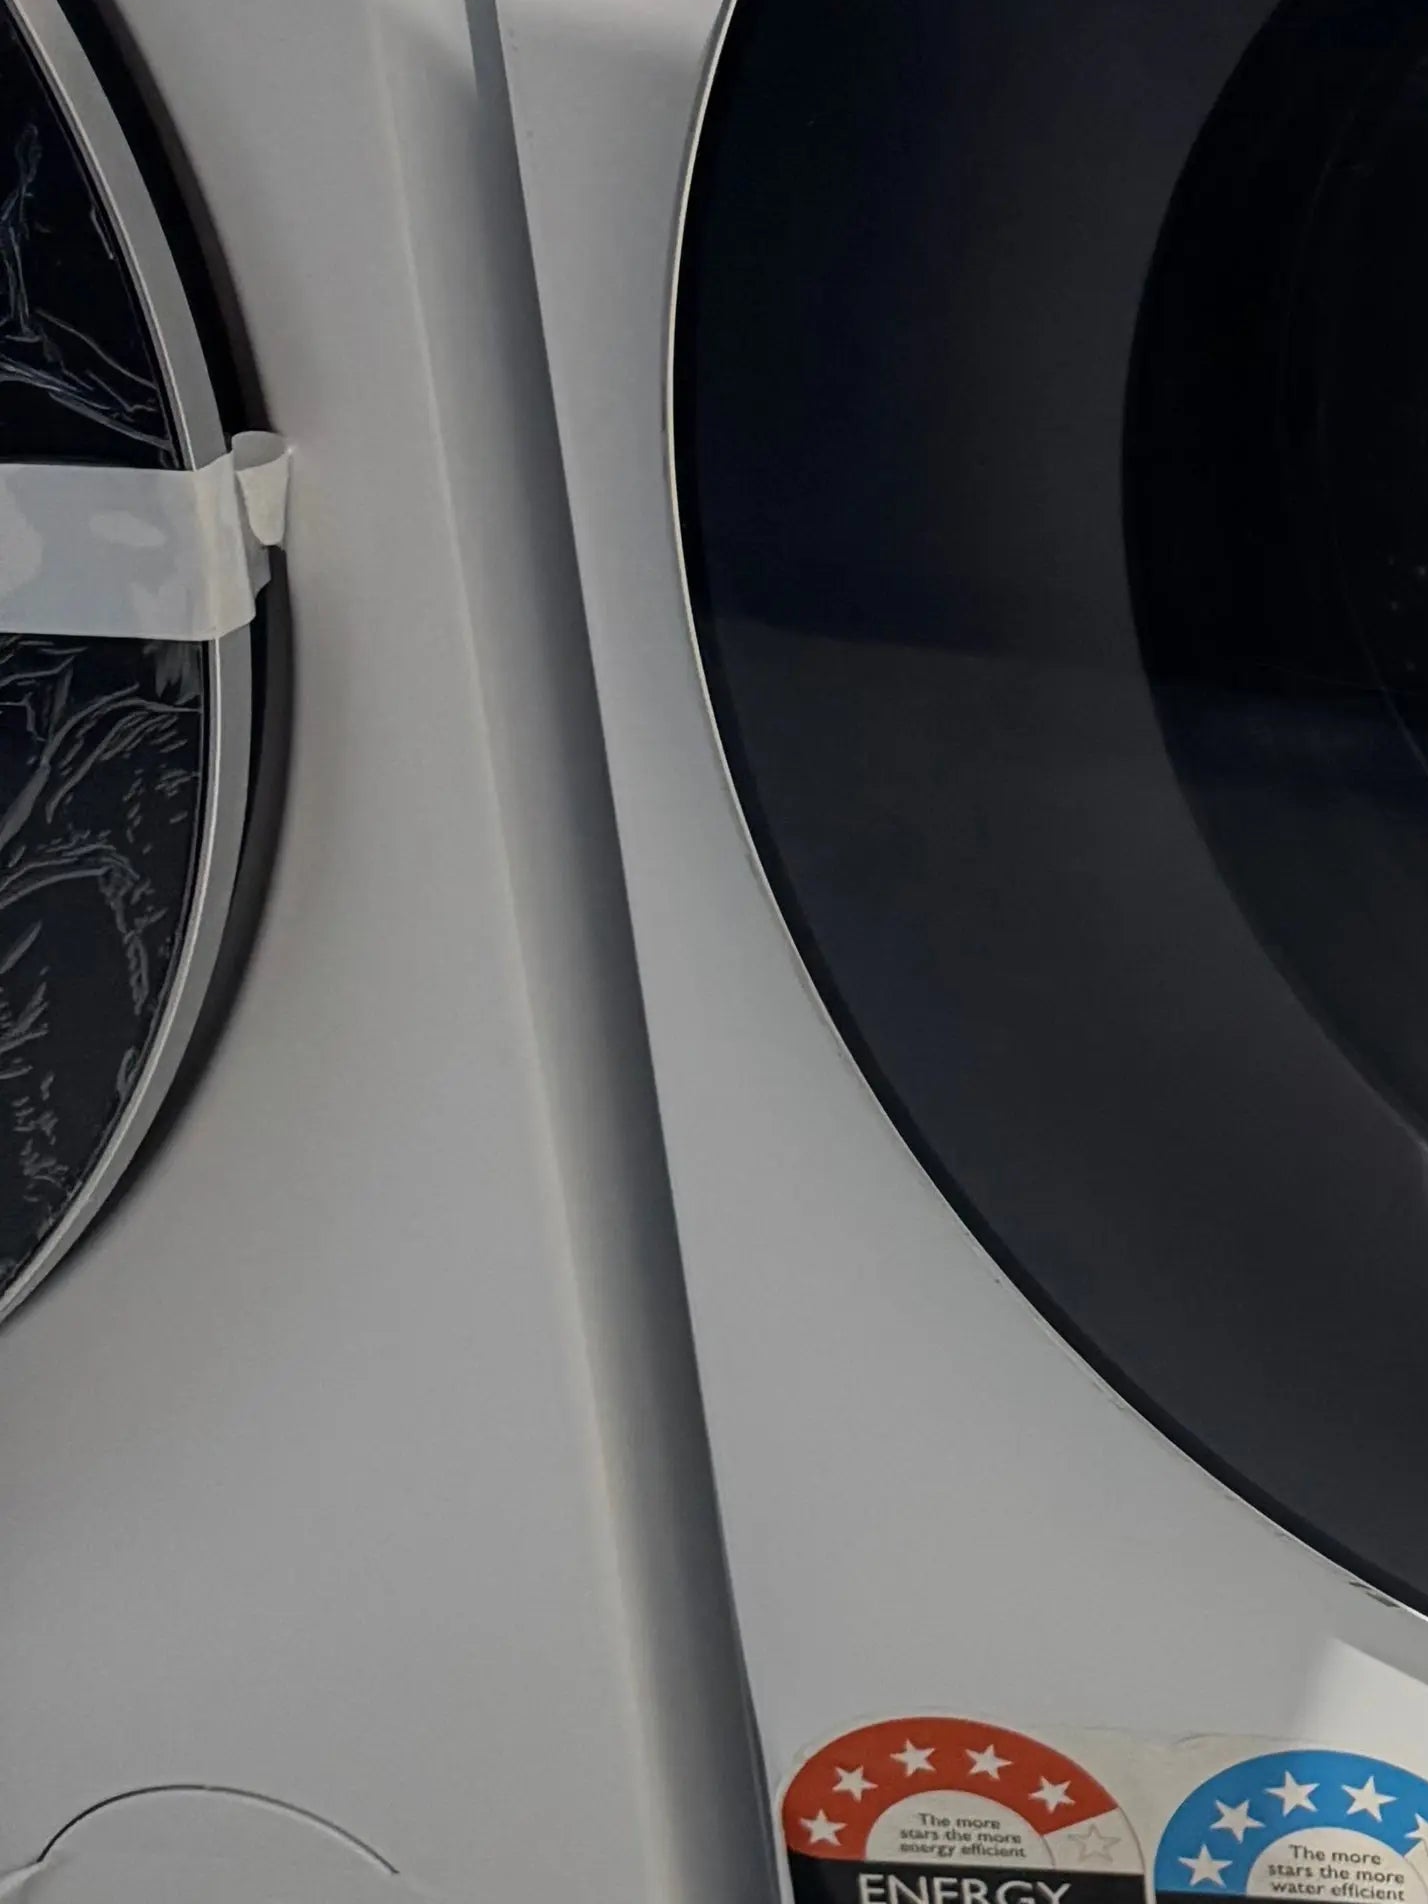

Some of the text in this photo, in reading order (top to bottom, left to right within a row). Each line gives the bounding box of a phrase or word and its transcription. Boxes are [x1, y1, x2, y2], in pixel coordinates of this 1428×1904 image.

[919, 1813, 1000, 1830] The more
[901, 1829, 1021, 1844] stars the more
[901, 1844, 1026, 1858] energy efficient
[1289, 1844, 1381, 1865] The more
[1268, 1864, 1405, 1885] stars the more
[1272, 1882, 1405, 1901] water efficient
